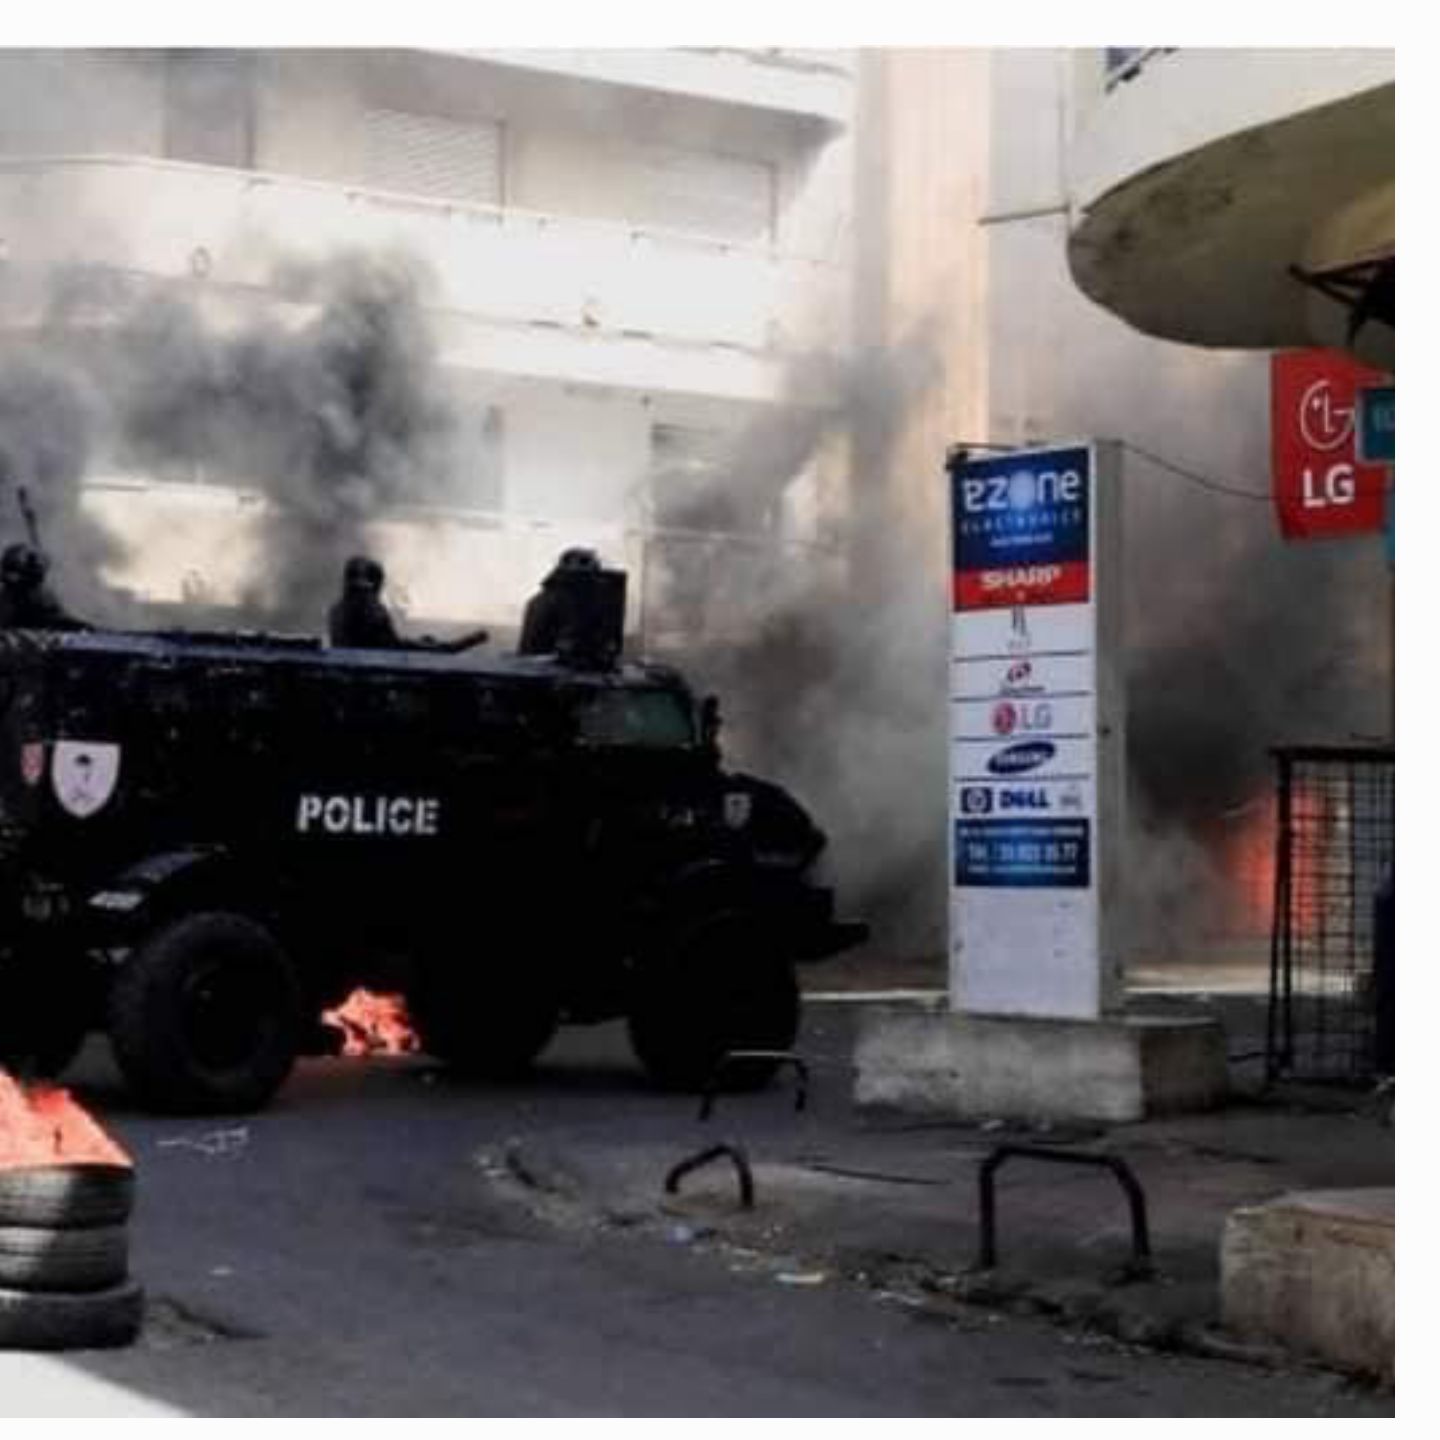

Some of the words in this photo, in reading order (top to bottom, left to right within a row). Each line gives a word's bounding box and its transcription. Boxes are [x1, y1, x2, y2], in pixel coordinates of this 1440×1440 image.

[1302, 463, 1356, 507] LG
[980, 564, 1061, 590] SHARP
[1021, 702, 1053, 731] LG
[1000, 789, 1051, 809] DELL
[296, 794, 439, 834] POLICE
